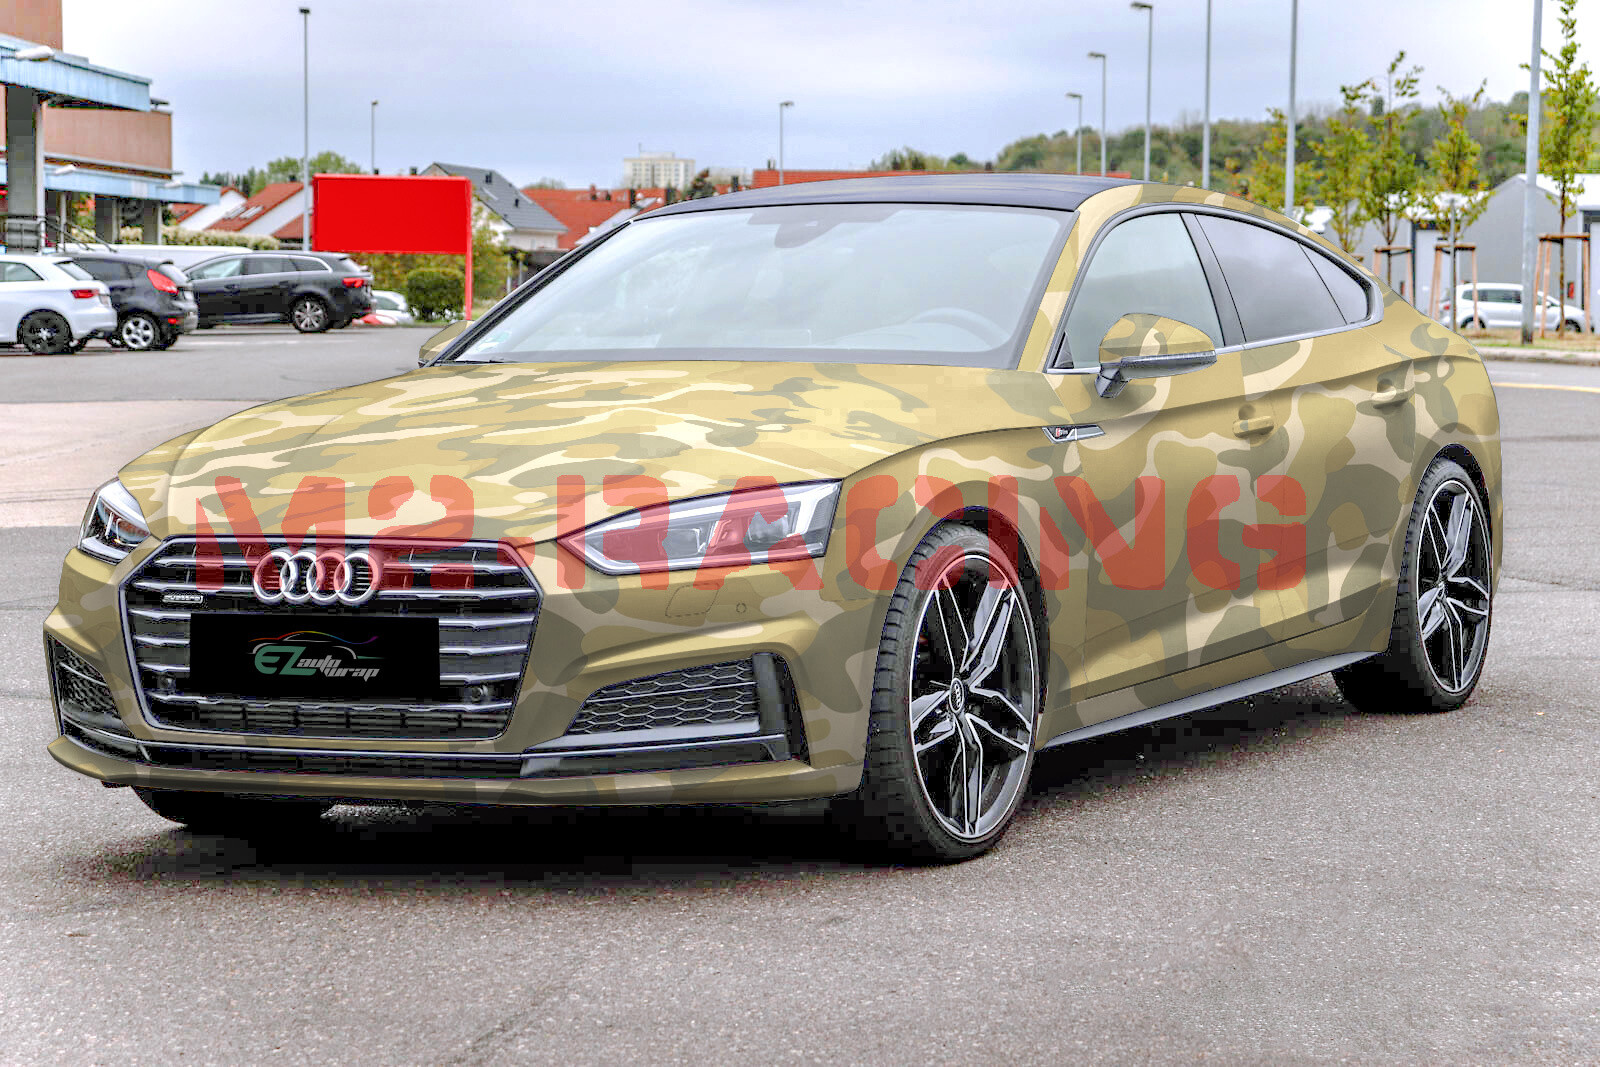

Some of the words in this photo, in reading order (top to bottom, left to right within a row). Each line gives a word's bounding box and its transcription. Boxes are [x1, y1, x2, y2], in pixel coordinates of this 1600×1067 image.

[255, 645, 317, 676] EZ
[297, 655, 342, 673] auto
[324, 667, 380, 682] wrap
